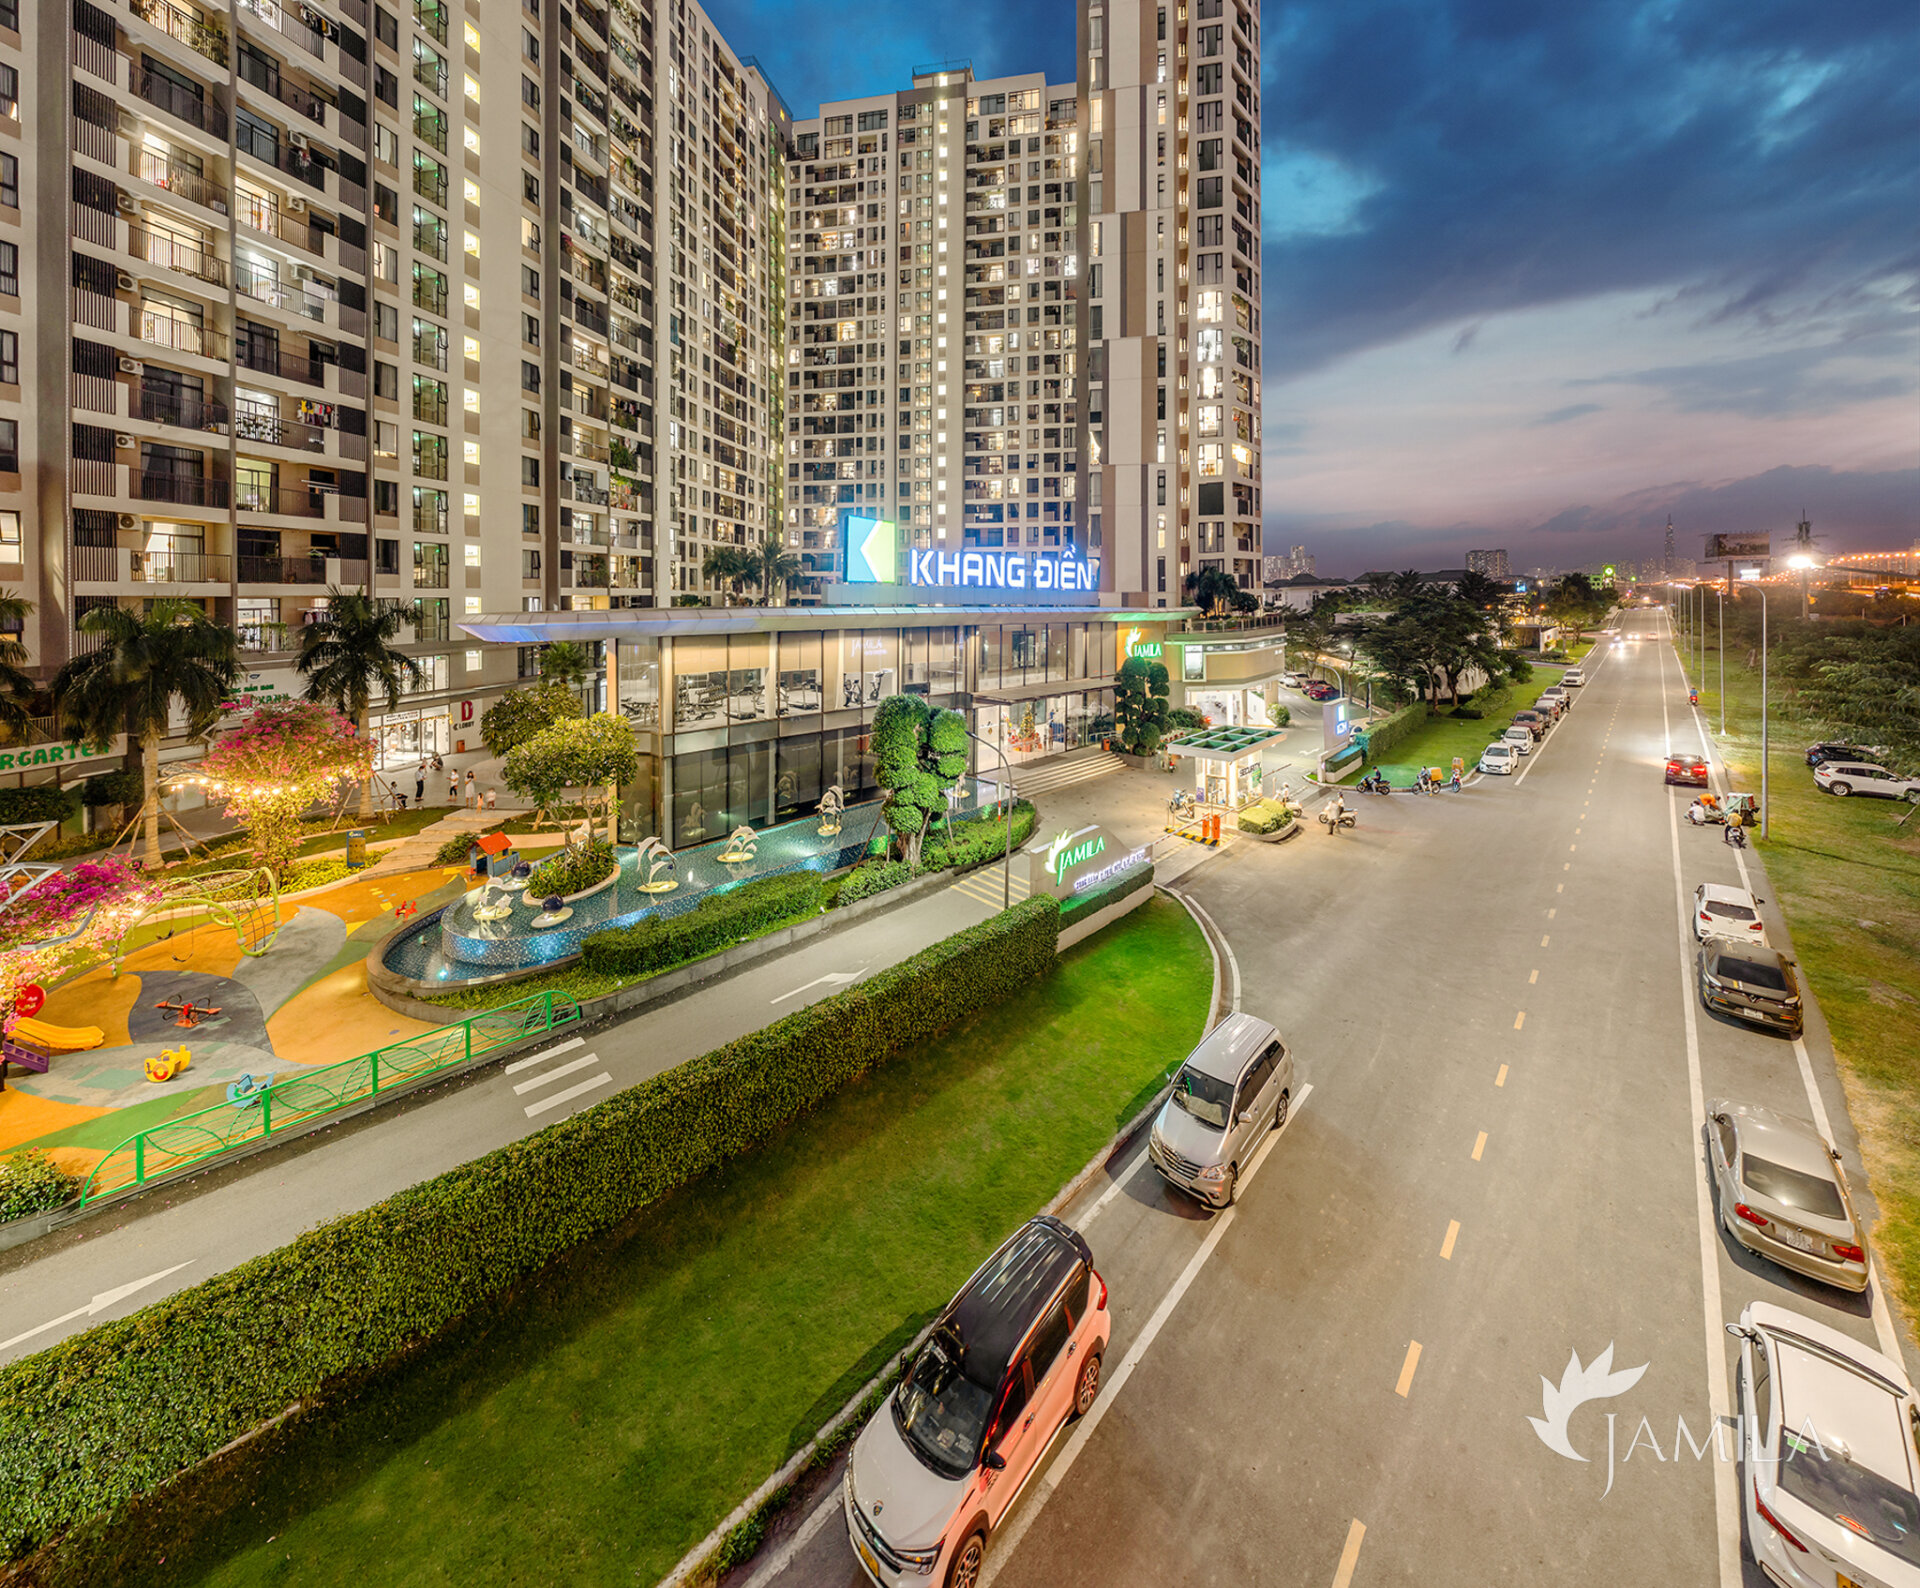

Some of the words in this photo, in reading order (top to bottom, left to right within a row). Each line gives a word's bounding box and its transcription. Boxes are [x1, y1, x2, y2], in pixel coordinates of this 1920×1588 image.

[910, 548, 1025, 588] KHANG
[1033, 544, 1092, 590] ĐIỀN
[458, 721, 475, 730] LOBBY
[461, 700, 473, 722] D
[1056, 835, 1105, 887] JAMILA
